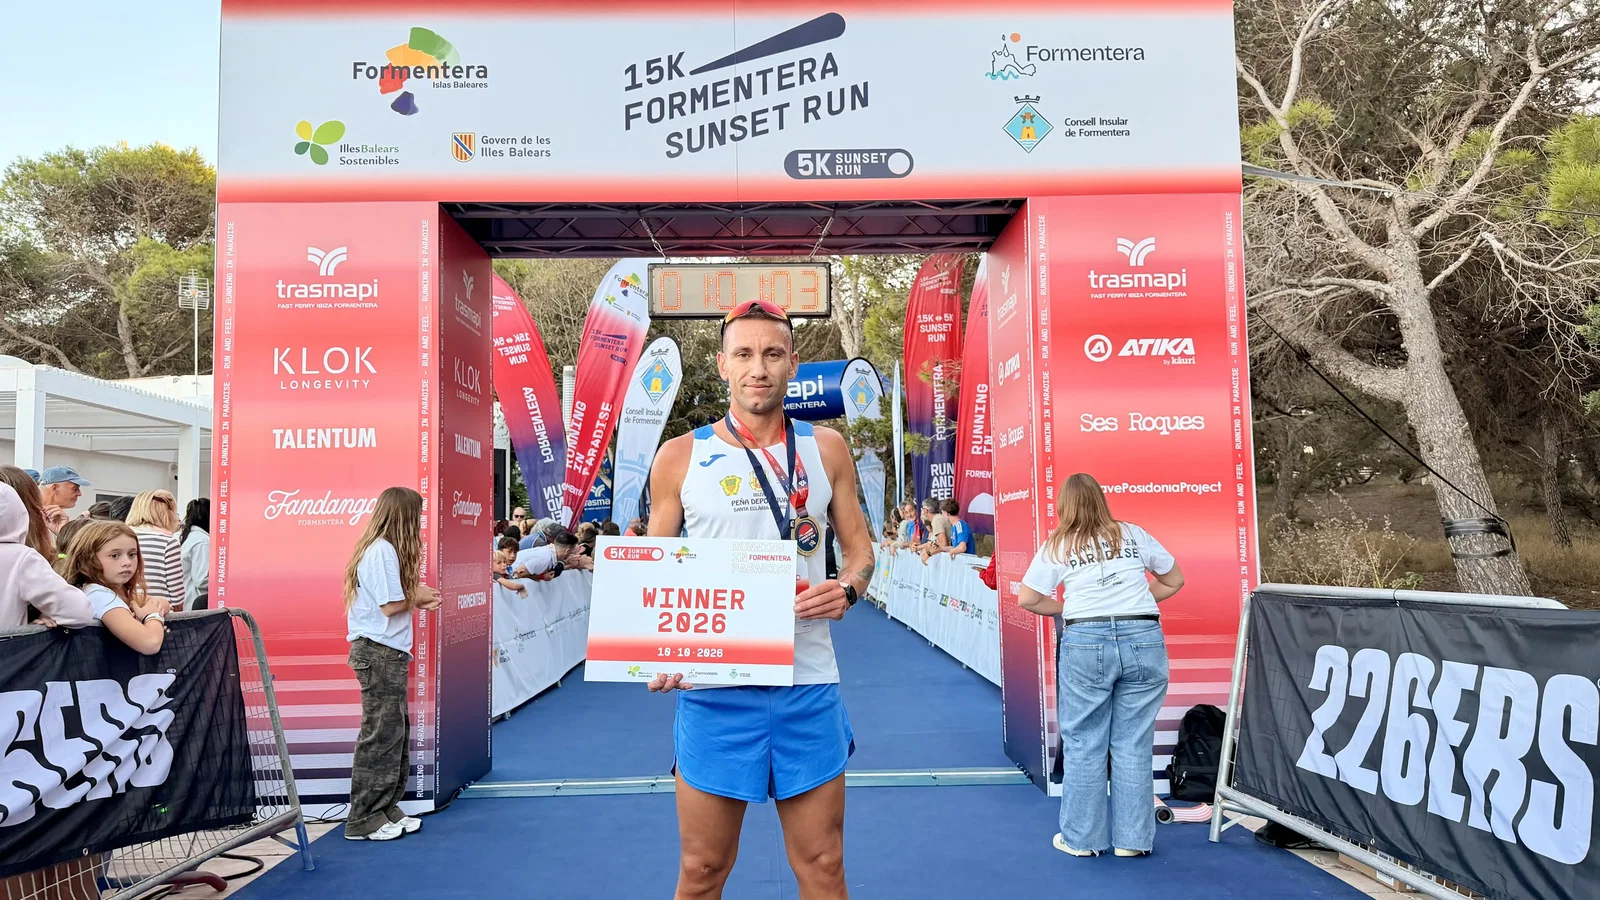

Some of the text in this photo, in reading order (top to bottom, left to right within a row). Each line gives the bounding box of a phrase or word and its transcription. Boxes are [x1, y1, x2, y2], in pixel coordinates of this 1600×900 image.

[1027, 45, 1144, 61] Formentera
[353, 62, 488, 79] Formentera
[624, 51, 685, 91] 15K
[625, 52, 838, 131] FORMENTERA
[666, 81, 868, 159] SUNSET RUN
[1065, 117, 1128, 126] Consell Insular
[1065, 128, 1130, 137] de Formentera
[340, 143, 399, 153] IllesBalears
[481, 135, 550, 146] Govern de les
[481, 148, 550, 157] Illes Balears
[835, 153, 887, 164] SUNSET
[339, 156, 399, 166] Sostenibles
[797, 153, 831, 176] 5K
[836, 165, 861, 175] RUN
[422, 258, 428, 267] IN
[1040, 253, 1045, 261] IN
[614, 274, 648, 297] Formentera
[1088, 269, 1187, 290] trasmapi
[276, 279, 378, 300] trasmapi
[455, 292, 481, 328] trasmapi
[917, 314, 934, 322] 15K
[920, 324, 952, 332] SUNSET
[590, 335, 624, 346] FORMENTERA
[928, 334, 945, 342] RUN
[595, 342, 614, 351] SUNSET
[1118, 338, 1195, 356] ATIKA
[274, 347, 377, 374] KLOK
[1005, 352, 1020, 379] ATIKA
[455, 357, 481, 394] KLOK
[281, 380, 370, 389] LONGEVITY
[456, 389, 479, 406] LONGEVITY
[626, 407, 663, 416] Consell Insula
[783, 401, 827, 410] MENTERA
[1234, 406, 1240, 415] IN
[971, 383, 988, 455] RUNNING
[1044, 409, 1050, 418] IN
[223, 421, 229, 430] IN
[422, 419, 428, 428] IN
[1080, 412, 1205, 435] Ses Roques
[273, 428, 376, 449] TALENTUM
[566, 400, 587, 468] RUNNING
[582, 402, 613, 476] PARADISE
[999, 425, 1024, 448] Ses Roques
[455, 433, 481, 459] TALENTUM
[573, 452, 584, 474] IN
[931, 463, 954, 476] RUN
[1101, 481, 1222, 495] avePosidoniaProject
[452, 490, 482, 526] Fandango
[731, 498, 749, 506] PEÑA
[610, 548, 625, 558] 5K
[733, 542, 784, 552] RUNNING
[732, 552, 747, 562] IN
[732, 563, 791, 574] PARADISE
[457, 592, 486, 610] FORMENTERA
[643, 587, 745, 610] WINNER
[444, 613, 486, 646] PARADISE
[658, 612, 726, 633] 2026
[1295, 645, 1600, 865] 226ERS
